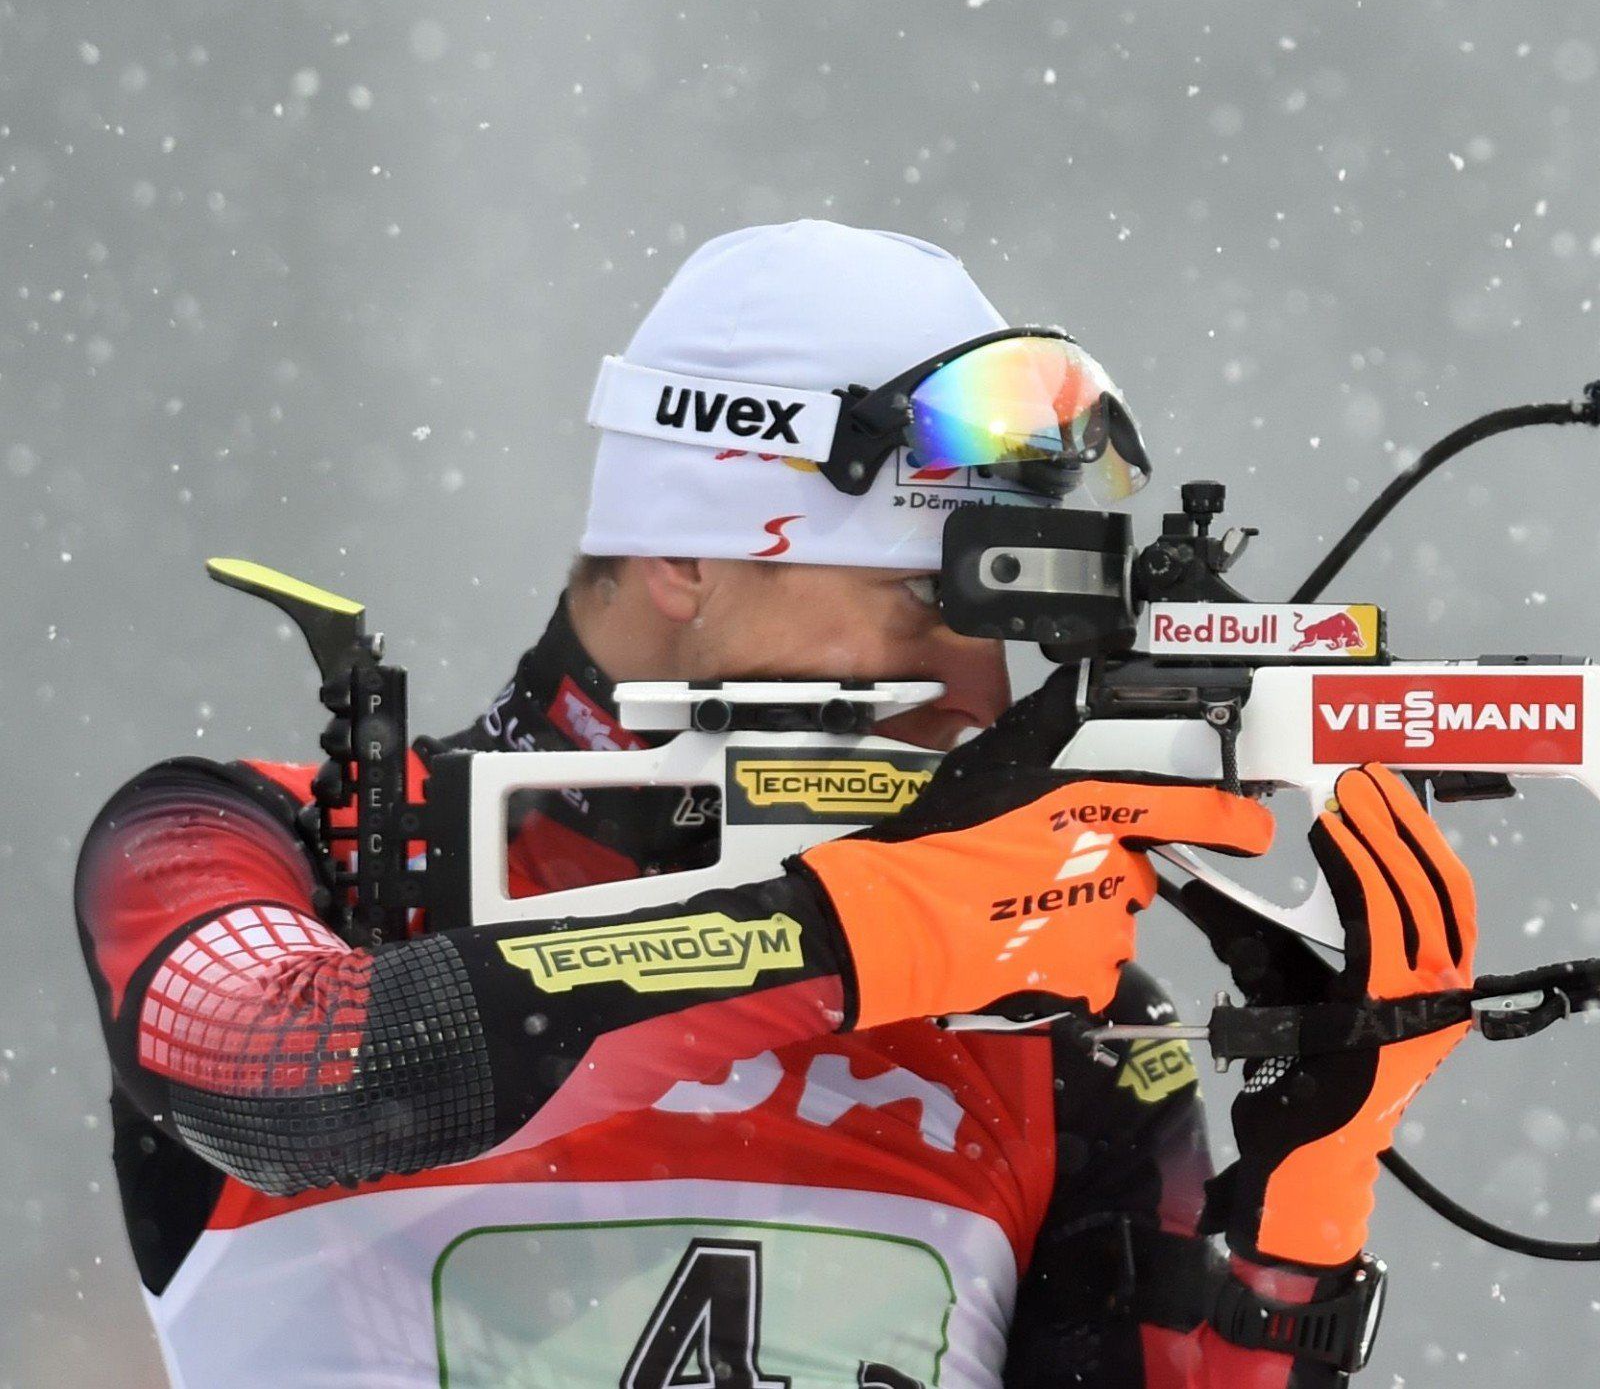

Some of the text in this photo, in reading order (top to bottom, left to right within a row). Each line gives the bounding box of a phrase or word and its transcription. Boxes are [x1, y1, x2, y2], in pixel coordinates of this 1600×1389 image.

[656, 385, 806, 444] uvex
[1154, 614, 1277, 644] Red Bull
[1319, 691, 1575, 748] VIESSMANN
[990, 875, 1125, 921] ziener
[511, 925, 791, 978] TECHNOGYM
[619, 1237, 792, 1389] 4
